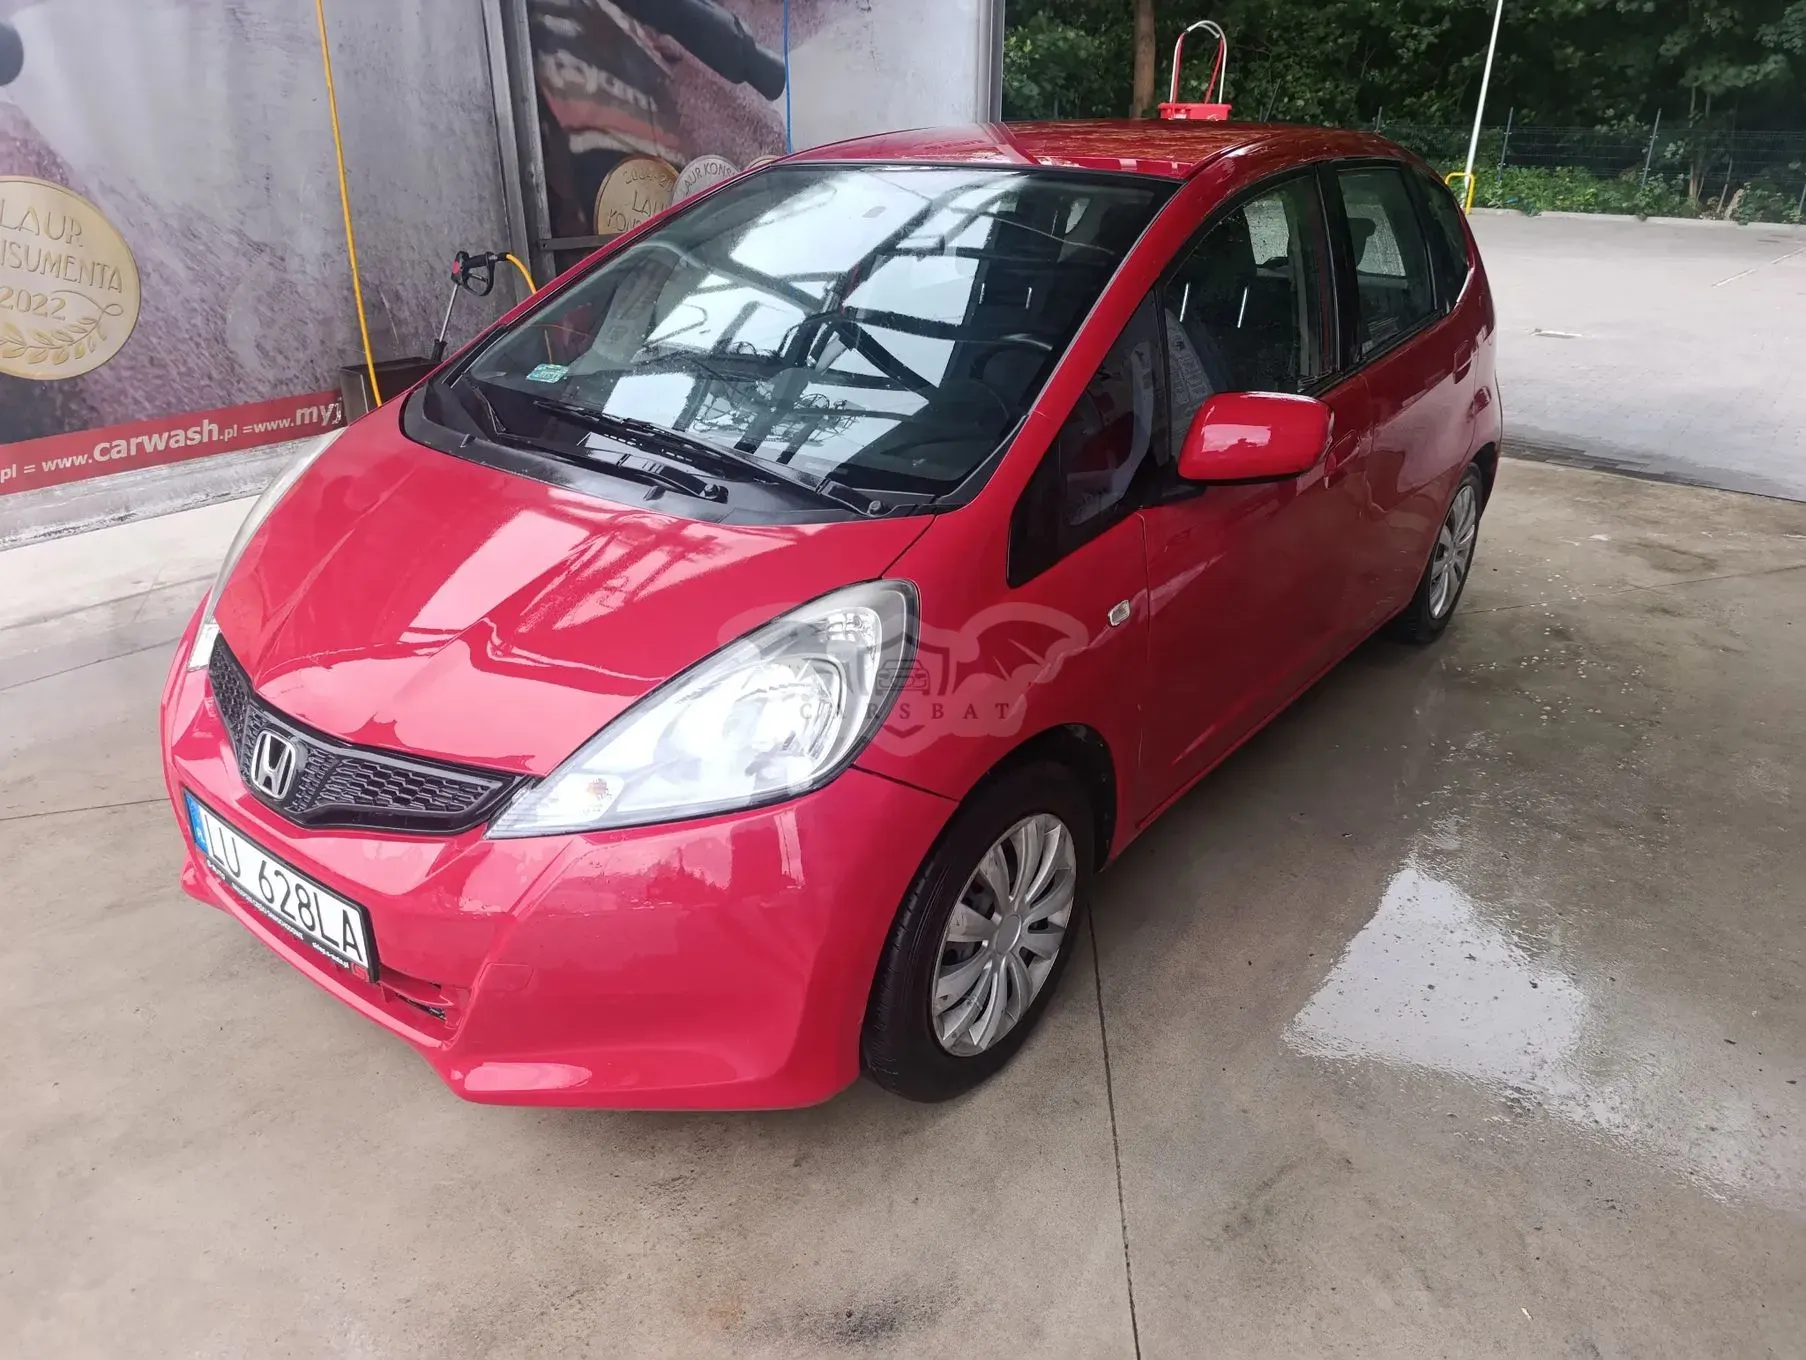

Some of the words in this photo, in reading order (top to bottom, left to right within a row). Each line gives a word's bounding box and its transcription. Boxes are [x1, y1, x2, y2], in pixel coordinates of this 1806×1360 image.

[0, 285, 66, 321] 2022
[204, 814, 242, 879] LU
[258, 860, 364, 963] 628LA
